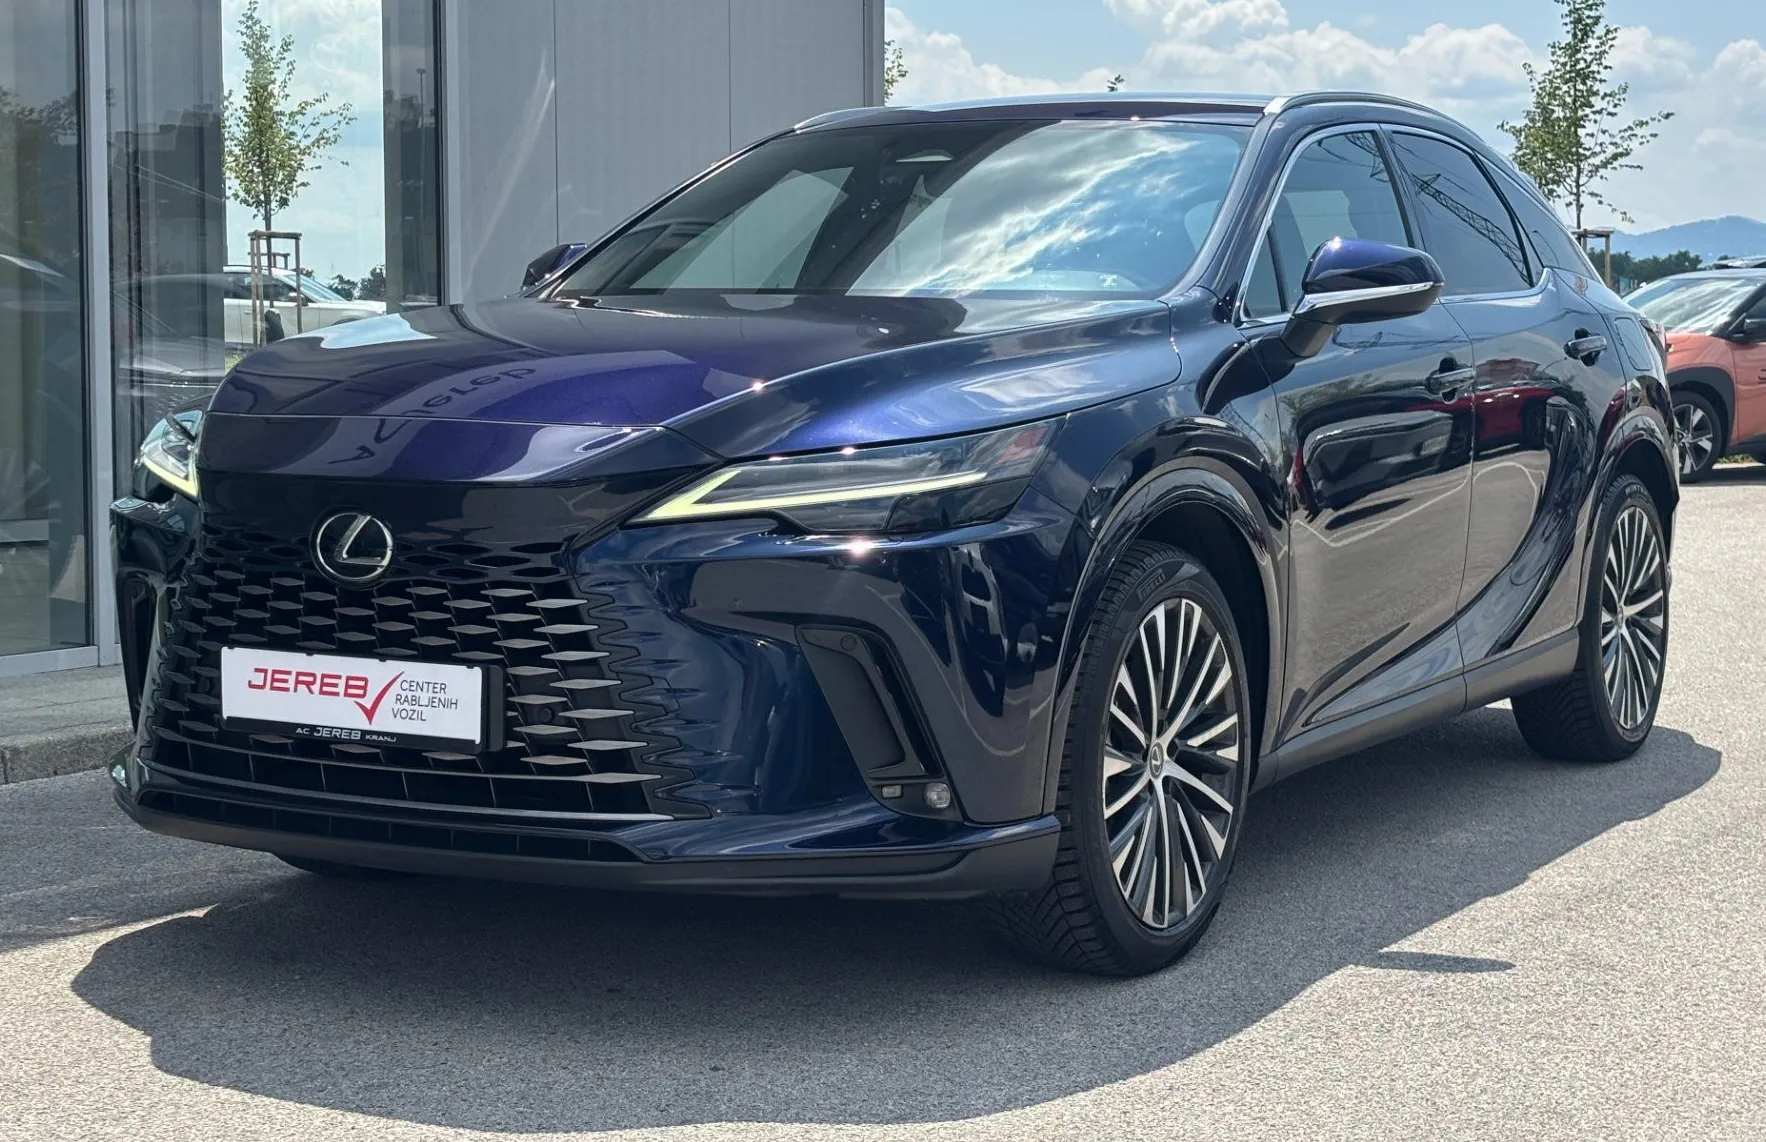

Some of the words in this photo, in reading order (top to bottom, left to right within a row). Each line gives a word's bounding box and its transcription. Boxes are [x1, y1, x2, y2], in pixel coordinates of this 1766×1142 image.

[247, 667, 369, 699] JEREB
[400, 679, 447, 695] CENTER
[394, 693, 459, 710] RABLJENIH
[391, 707, 427, 722] VOZIL
[295, 727, 310, 735] AC
[313, 726, 362, 740] JEREB
[365, 734, 397, 742] KRANJ
